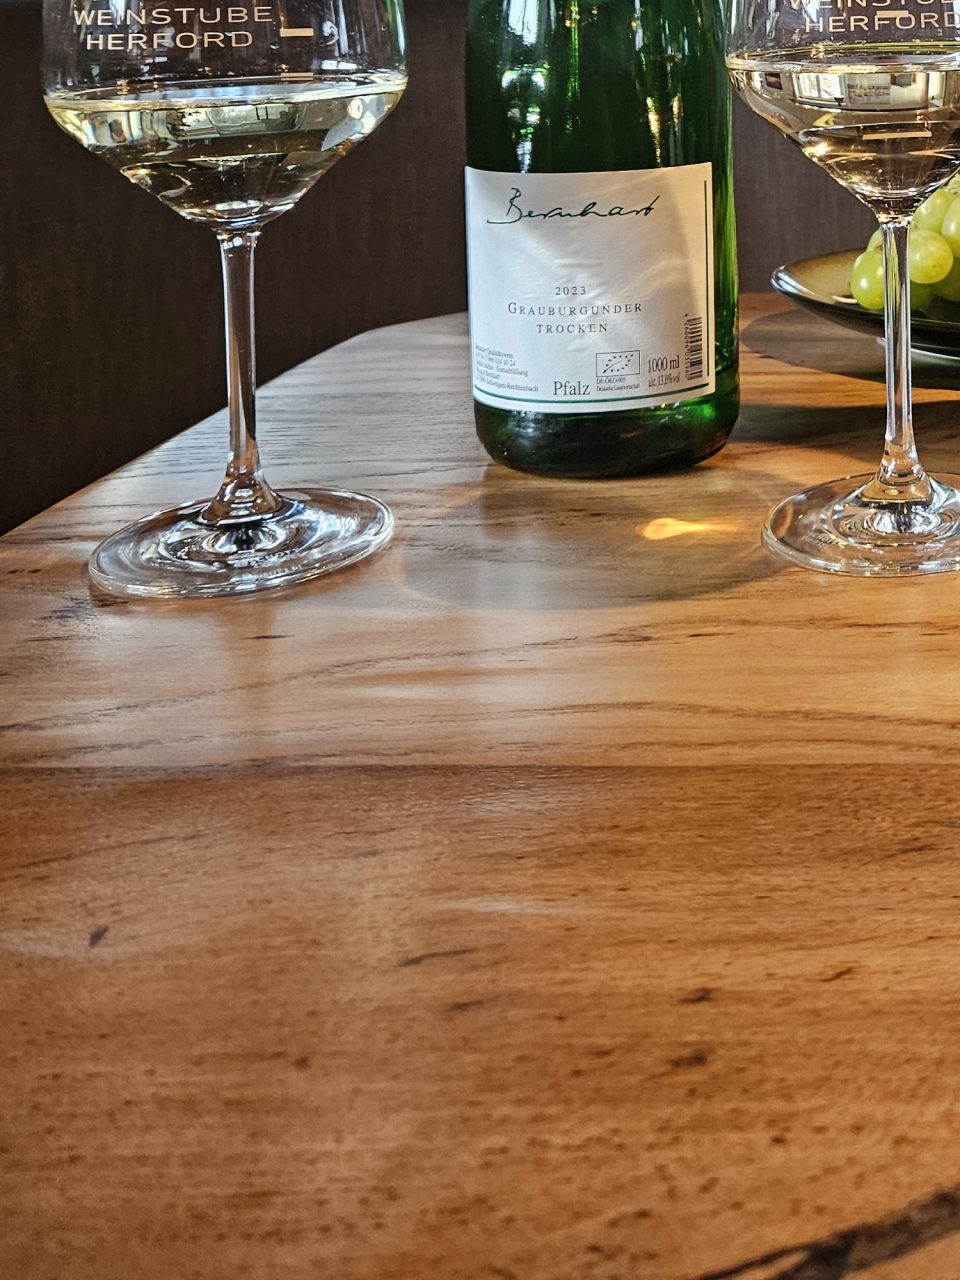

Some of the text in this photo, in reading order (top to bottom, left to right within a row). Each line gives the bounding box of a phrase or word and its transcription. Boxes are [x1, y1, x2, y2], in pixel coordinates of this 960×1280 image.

[73, 6, 274, 26] WEINSTUBE
[86, 30, 254, 50] HERFORD
[487, 187, 661, 225] Bernhart
[555, 286, 587, 296] 2023
[507, 301, 643, 317] GRAUBURGUNDER
[536, 323, 609, 334] TROCKEN
[647, 355, 680, 373] 1000 ml
[553, 380, 591, 396] Pfalz
